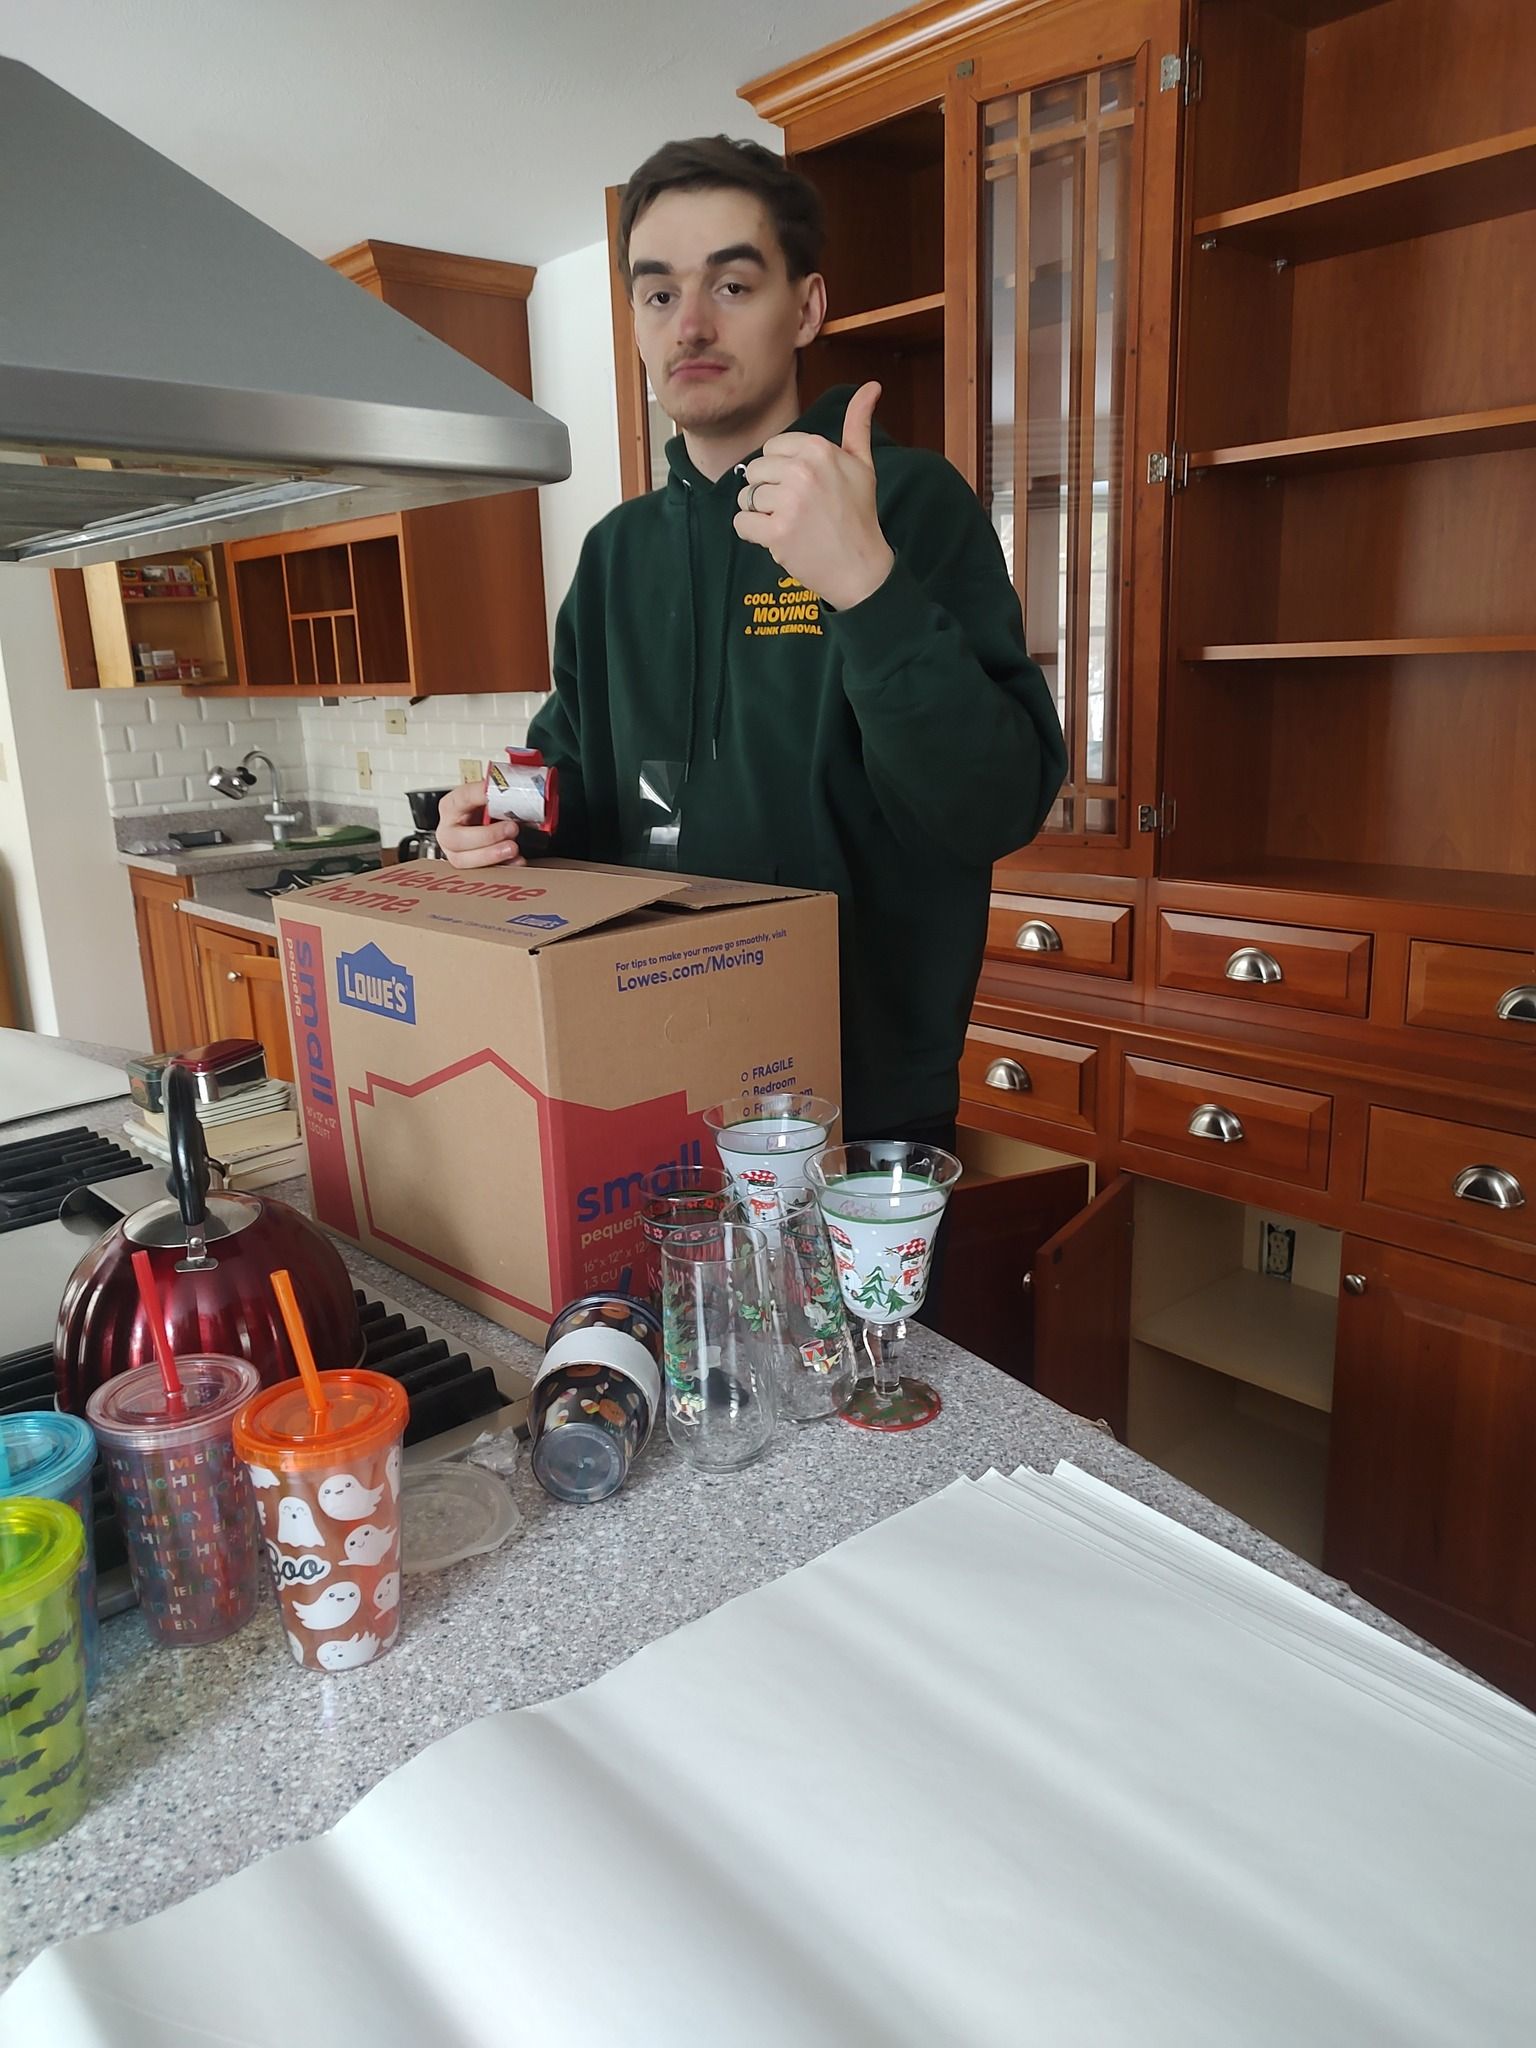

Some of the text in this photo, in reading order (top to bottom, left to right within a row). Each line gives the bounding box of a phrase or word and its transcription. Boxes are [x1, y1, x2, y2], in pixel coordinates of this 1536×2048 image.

[744, 593, 776, 605] COOL
[753, 604, 819, 623] MOVING
[744, 624, 823, 635] & JUNK REMOVAL
[306, 883, 420, 914] home.
[368, 868, 546, 901] Welcome
[616, 929, 787, 972] For tips to make your move go smoothly, visit
[617, 949, 764, 993] Lowes.com/Moving
[344, 964, 407, 1014] LOWE'S
[296, 938, 334, 1105] small
[752, 1057, 794, 1080] FRAGILE
[753, 1076, 797, 1096] Bedroom
[577, 1140, 701, 1222] small
[581, 1211, 645, 1249] pequeñ
[600, 1267, 618, 1284] CU
